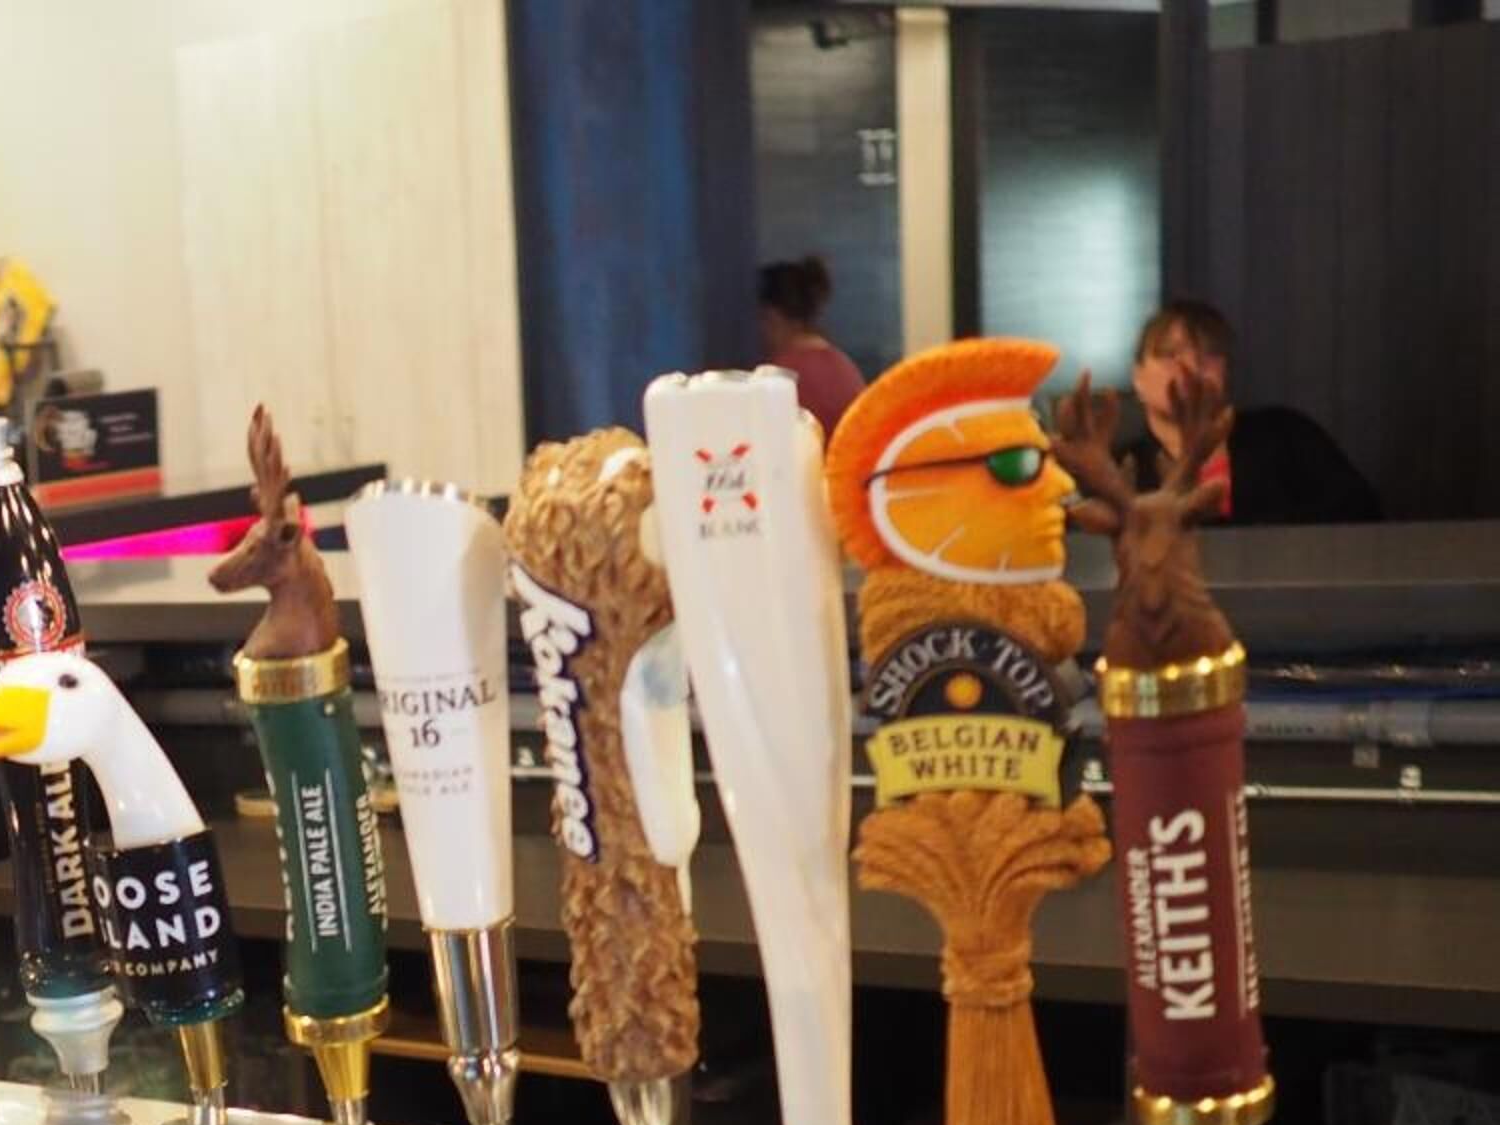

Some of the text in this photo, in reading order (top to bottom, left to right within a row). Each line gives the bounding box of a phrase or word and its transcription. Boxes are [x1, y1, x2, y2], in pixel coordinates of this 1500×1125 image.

[869, 627, 1054, 716] SHOCK TOP
[410, 719, 442, 748] 16
[889, 724, 1041, 757] BELGIAN
[910, 753, 1022, 781] WHITE
[48, 823, 95, 940] DARK
[93, 860, 215, 909] OOSE
[301, 783, 340, 938] INDIA PALE ALE
[356, 795, 384, 915] ALEXANDER
[100, 905, 221, 950] LAND
[1127, 847, 1157, 989] ALEXANDER
[1150, 808, 1217, 1020] KEITH'S
[125, 948, 219, 976] COMPANY
